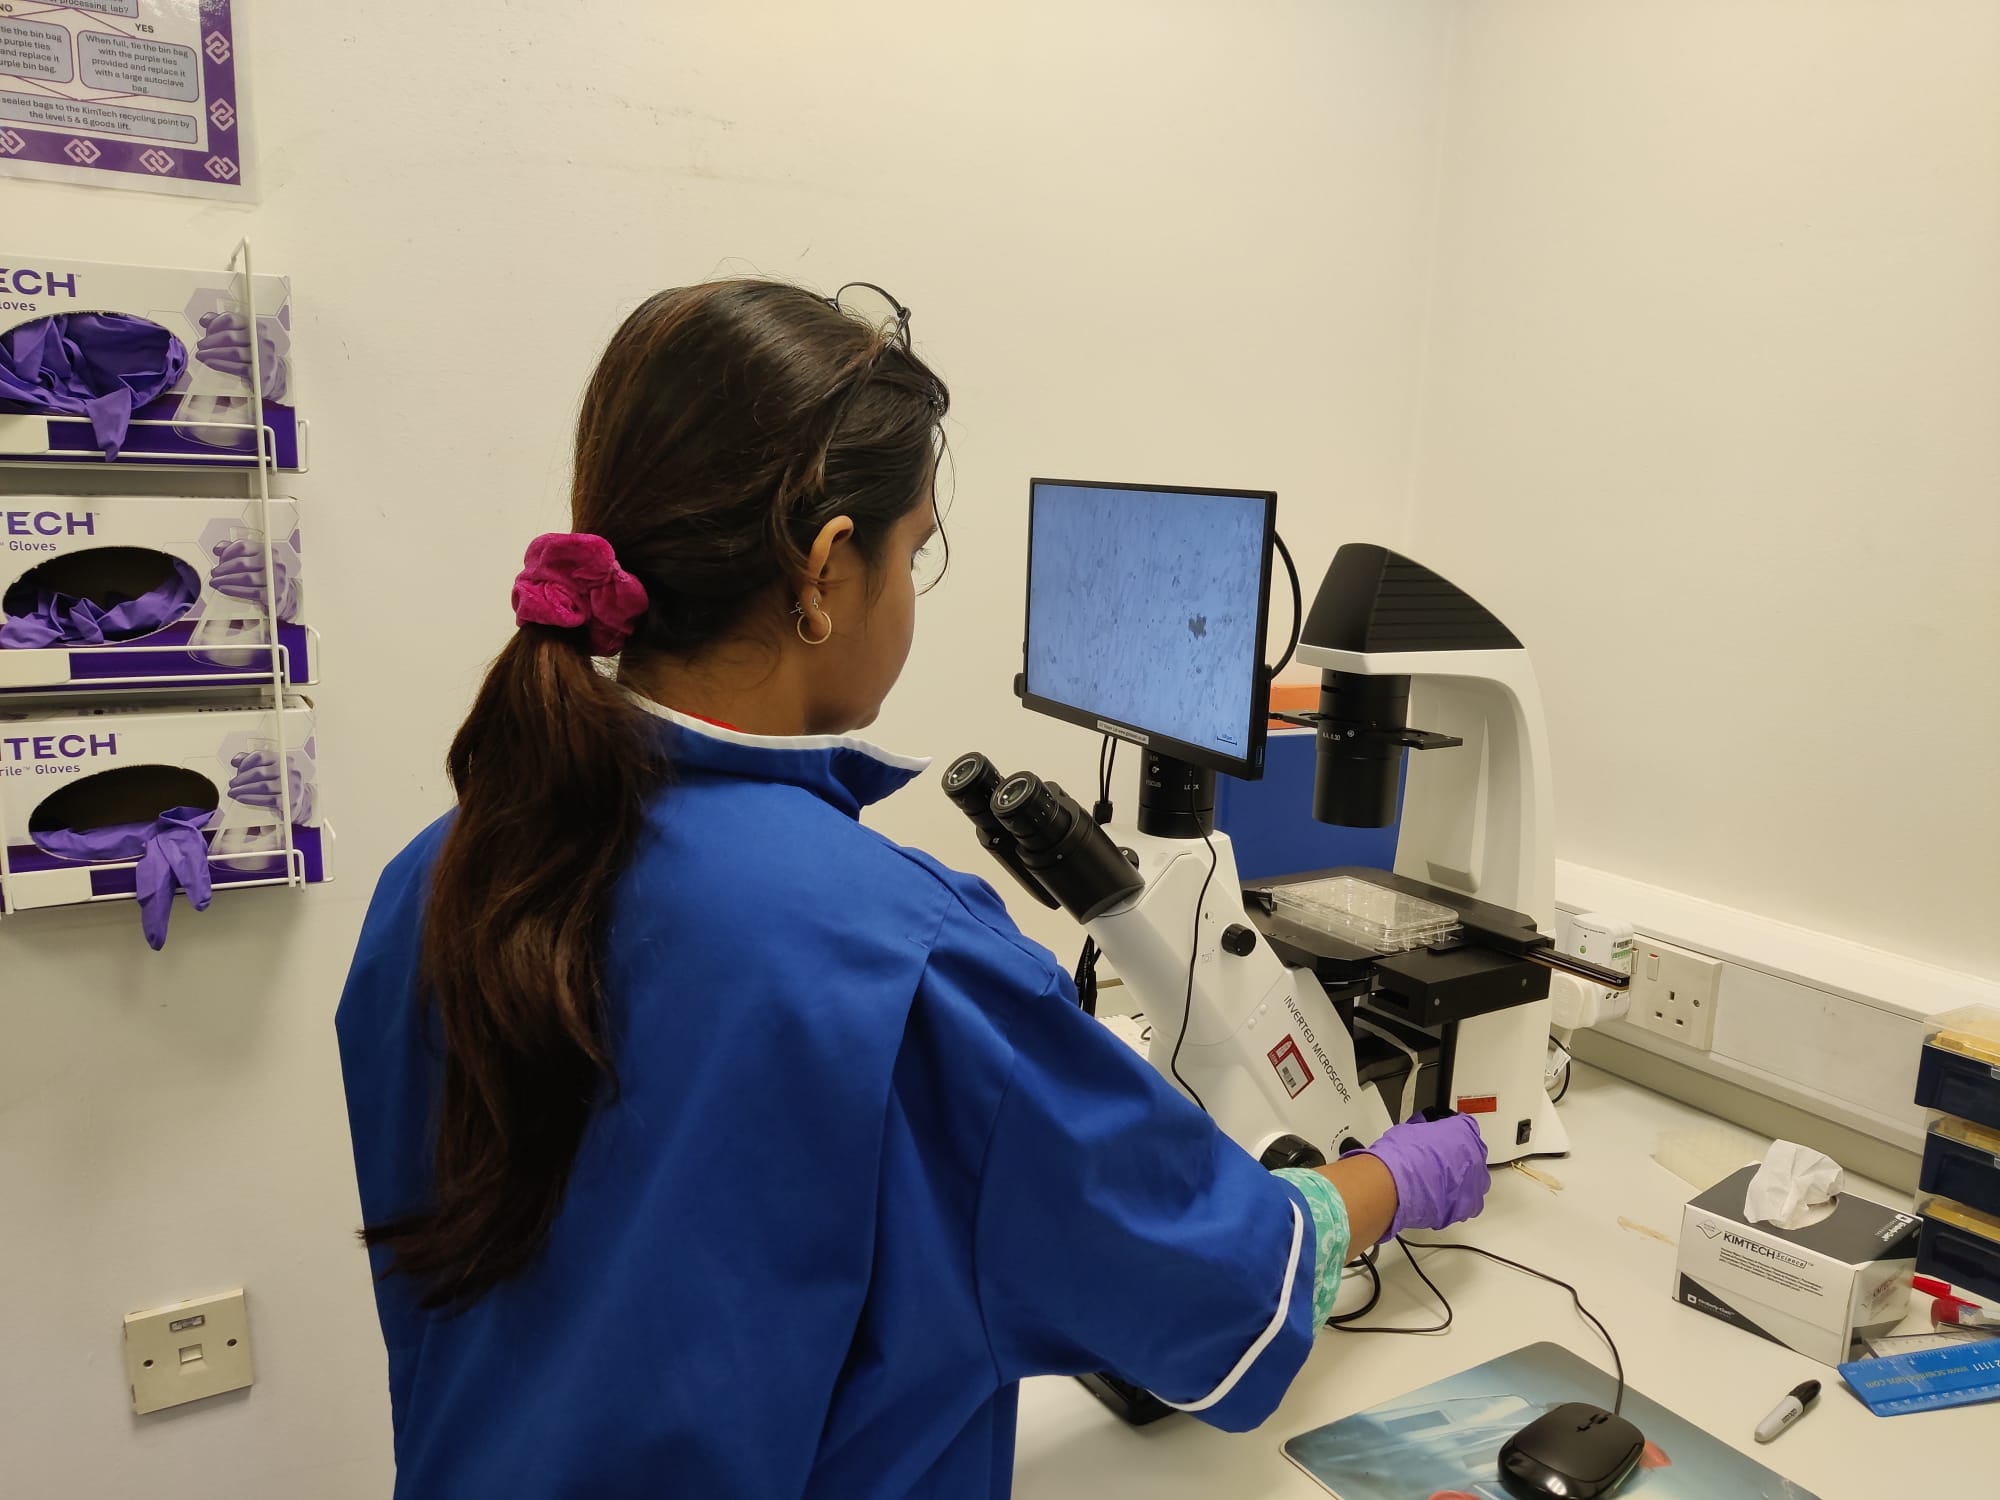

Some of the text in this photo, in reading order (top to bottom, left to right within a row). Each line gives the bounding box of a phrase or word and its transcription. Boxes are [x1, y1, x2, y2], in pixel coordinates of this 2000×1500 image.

[110, 4, 129, 14] lab?
[13, 27, 28, 36] the
[30, 30, 44, 38] bin
[45, 32, 62, 43] bag
[135, 23, 154, 34] YES
[3, 38, 51, 51] purple ties
[85, 34, 112, 45] When
[131, 42, 142, 50] tie
[143, 44, 157, 53] the
[158, 46, 172, 55] bin
[173, 49, 189, 59] bag
[0, 48, 60, 63] and replace it
[98, 48, 178, 66] with the purple ties
[22, 61, 37, 70] bin
[38, 63, 57, 74] bag.
[91, 57, 187, 78] provided and replace it
[94, 69, 114, 78] with
[122, 72, 143, 83] large
[144, 77, 185, 88] autoclave
[2, 97, 191, 129] sealed bags to the KimTech recycling point by
[29, 110, 45, 119] the
[45, 112, 67, 122] level
[67, 116, 74, 124] 5
[74, 117, 82, 125] &
[90, 119, 116, 129] goods
[117, 122, 133, 131] lift.
[0, 301, 36, 312] oves
[0, 511, 95, 536] ECH
[9, 540, 57, 551] Gloves
[0, 733, 118, 761] TECH
[35, 764, 81, 776] Gloves
[1283, 995, 1352, 1104] INVERTED MICROSCOPE
[1723, 1232, 1775, 1259] KIMTECH
